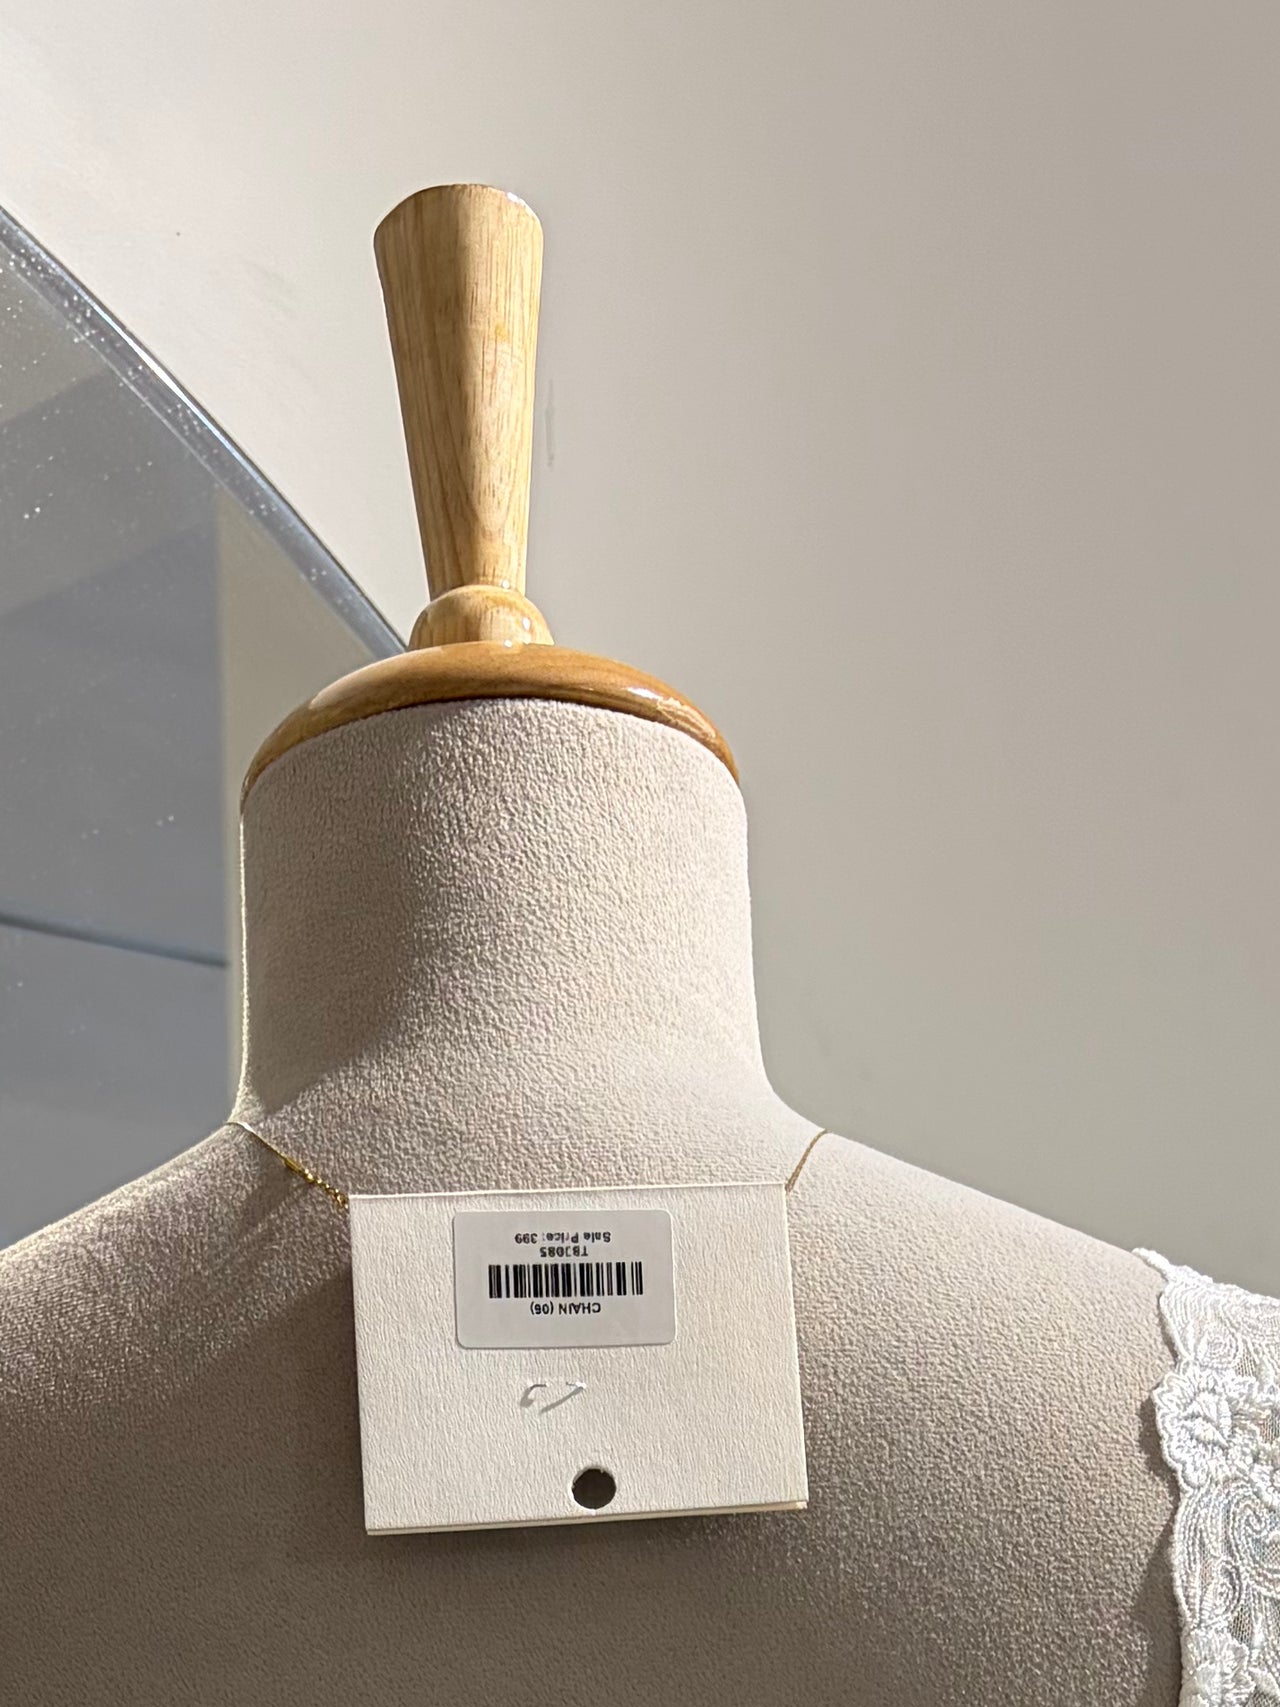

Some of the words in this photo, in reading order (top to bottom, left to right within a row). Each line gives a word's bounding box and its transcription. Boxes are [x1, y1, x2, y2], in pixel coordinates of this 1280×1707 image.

[514, 1232, 538, 1245] 399
[542, 1232, 579, 1244] Price:
[583, 1231, 611, 1243] Sale
[539, 1245, 588, 1258] TBJ085
[558, 1302, 601, 1315] CHAIN
